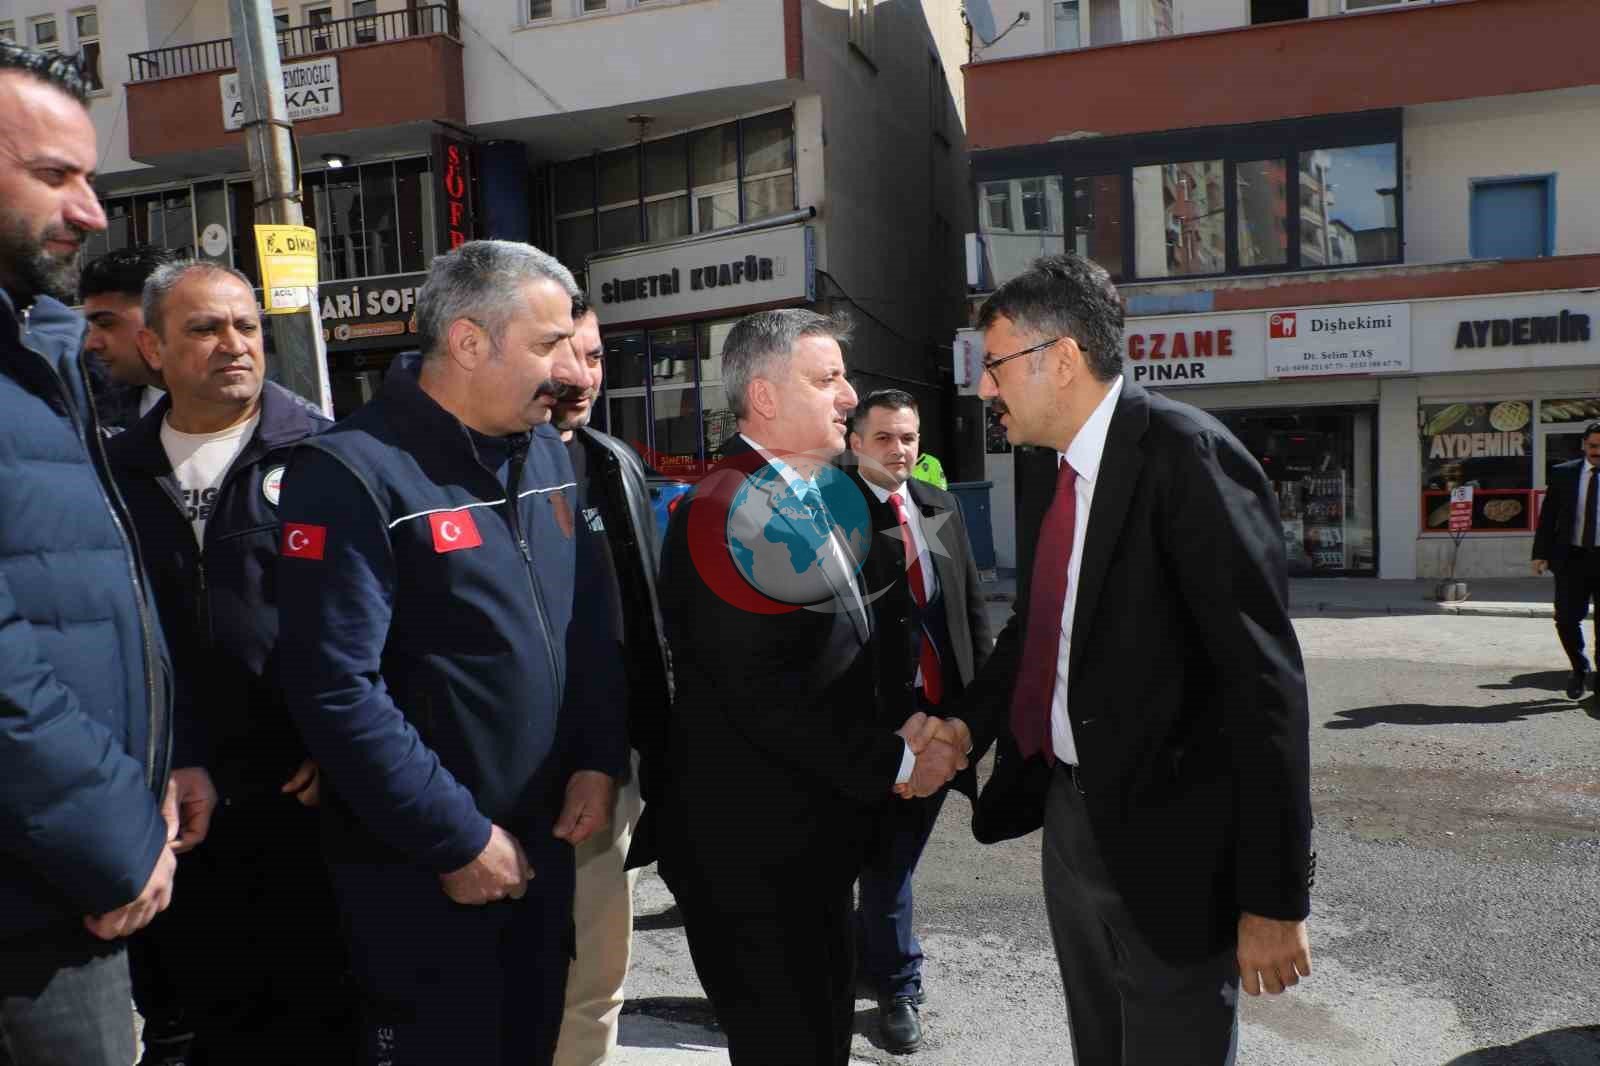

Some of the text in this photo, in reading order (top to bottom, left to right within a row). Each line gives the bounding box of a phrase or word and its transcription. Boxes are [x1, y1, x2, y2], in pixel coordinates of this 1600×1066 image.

[320, 285, 415, 320] ARİ SOF
[1311, 314, 1393, 335] Dişhekimi
[1127, 329, 1234, 361] CZANE
[1133, 362, 1207, 382] PINAR
